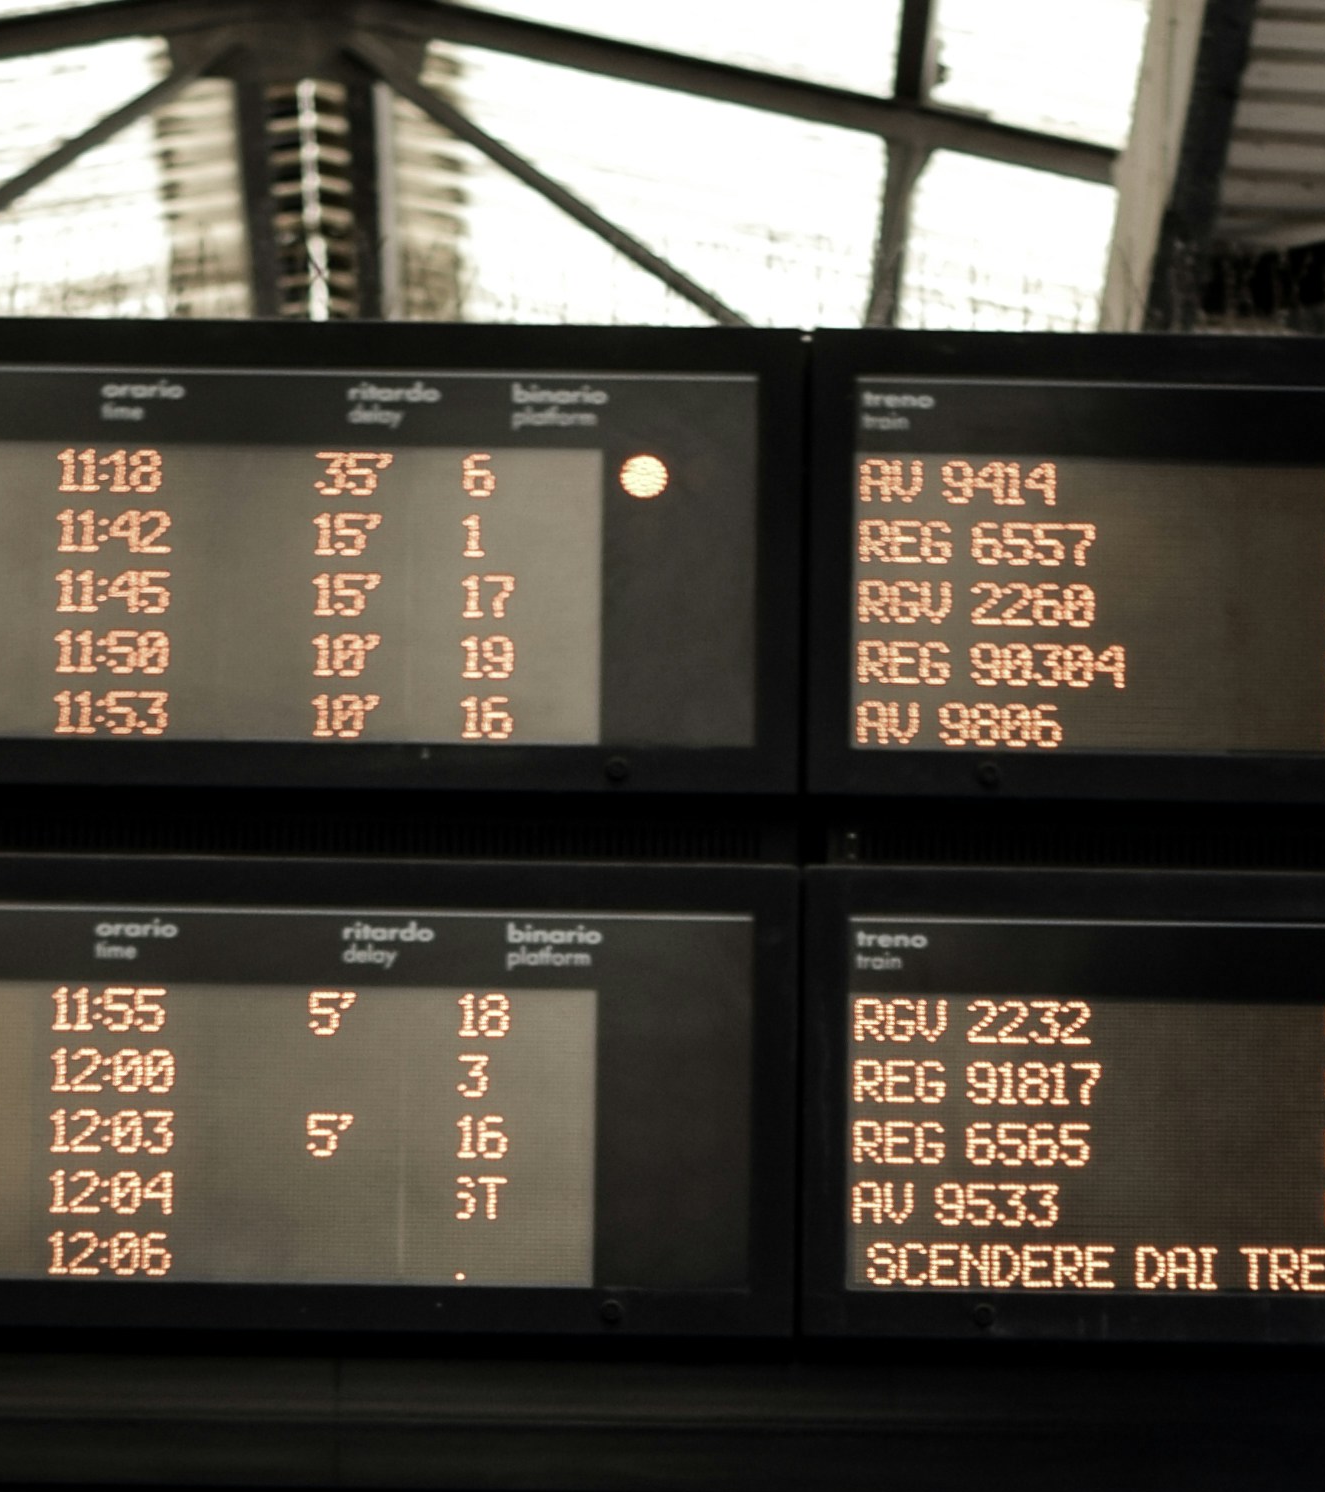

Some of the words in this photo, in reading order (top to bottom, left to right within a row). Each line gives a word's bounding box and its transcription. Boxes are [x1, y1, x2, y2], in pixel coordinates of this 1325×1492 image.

[58, 449, 163, 494] 11:18
[463, 454, 497, 499] 6
[860, 460, 925, 504] AV
[942, 461, 1058, 507] 9414
[57, 510, 173, 555] 11:42
[462, 515, 487, 559] 1
[859, 520, 954, 566] REG
[971, 522, 1097, 568] 6557
[56, 570, 172, 615] 11:45
[462, 575, 516, 620] 17
[859, 581, 954, 626] RGV
[971, 583, 1097, 629] 2260
[55, 630, 171, 676] 11:50
[461, 636, 516, 680] 19
[858, 641, 952, 686] REG
[54, 691, 169, 736] 11:53
[461, 696, 515, 741] 16
[857, 701, 921, 746] AV
[94, 918, 179, 939] orario
[341, 921, 435, 942] ritardo
[505, 922, 603, 945] binario
[856, 930, 928, 949] treno
[341, 944, 397, 969] delay
[505, 948, 592, 971] platform
[856, 953, 902, 970] train
[52, 987, 168, 1034] 11:55
[458, 994, 512, 1039] 18
[854, 998, 949, 1044] RGV
[968, 1001, 1093, 1046] 2232
[51, 1048, 176, 1095] 12:00
[457, 1055, 491, 1099] 3
[854, 1060, 948, 1105] REG
[967, 1062, 1103, 1107] 91817
[50, 1109, 175, 1156] 12:03
[457, 1115, 510, 1161] 16
[853, 1121, 947, 1166] REG
[966, 1123, 1092, 1168] 6565
[50, 1170, 175, 1216] 12:04
[853, 1182, 916, 1226] AV
[935, 1184, 1060, 1229] 9533
[49, 1232, 173, 1277] 12:06
[867, 1243, 1116, 1289] SCENDERE
[1136, 1247, 1219, 1291] DAI
